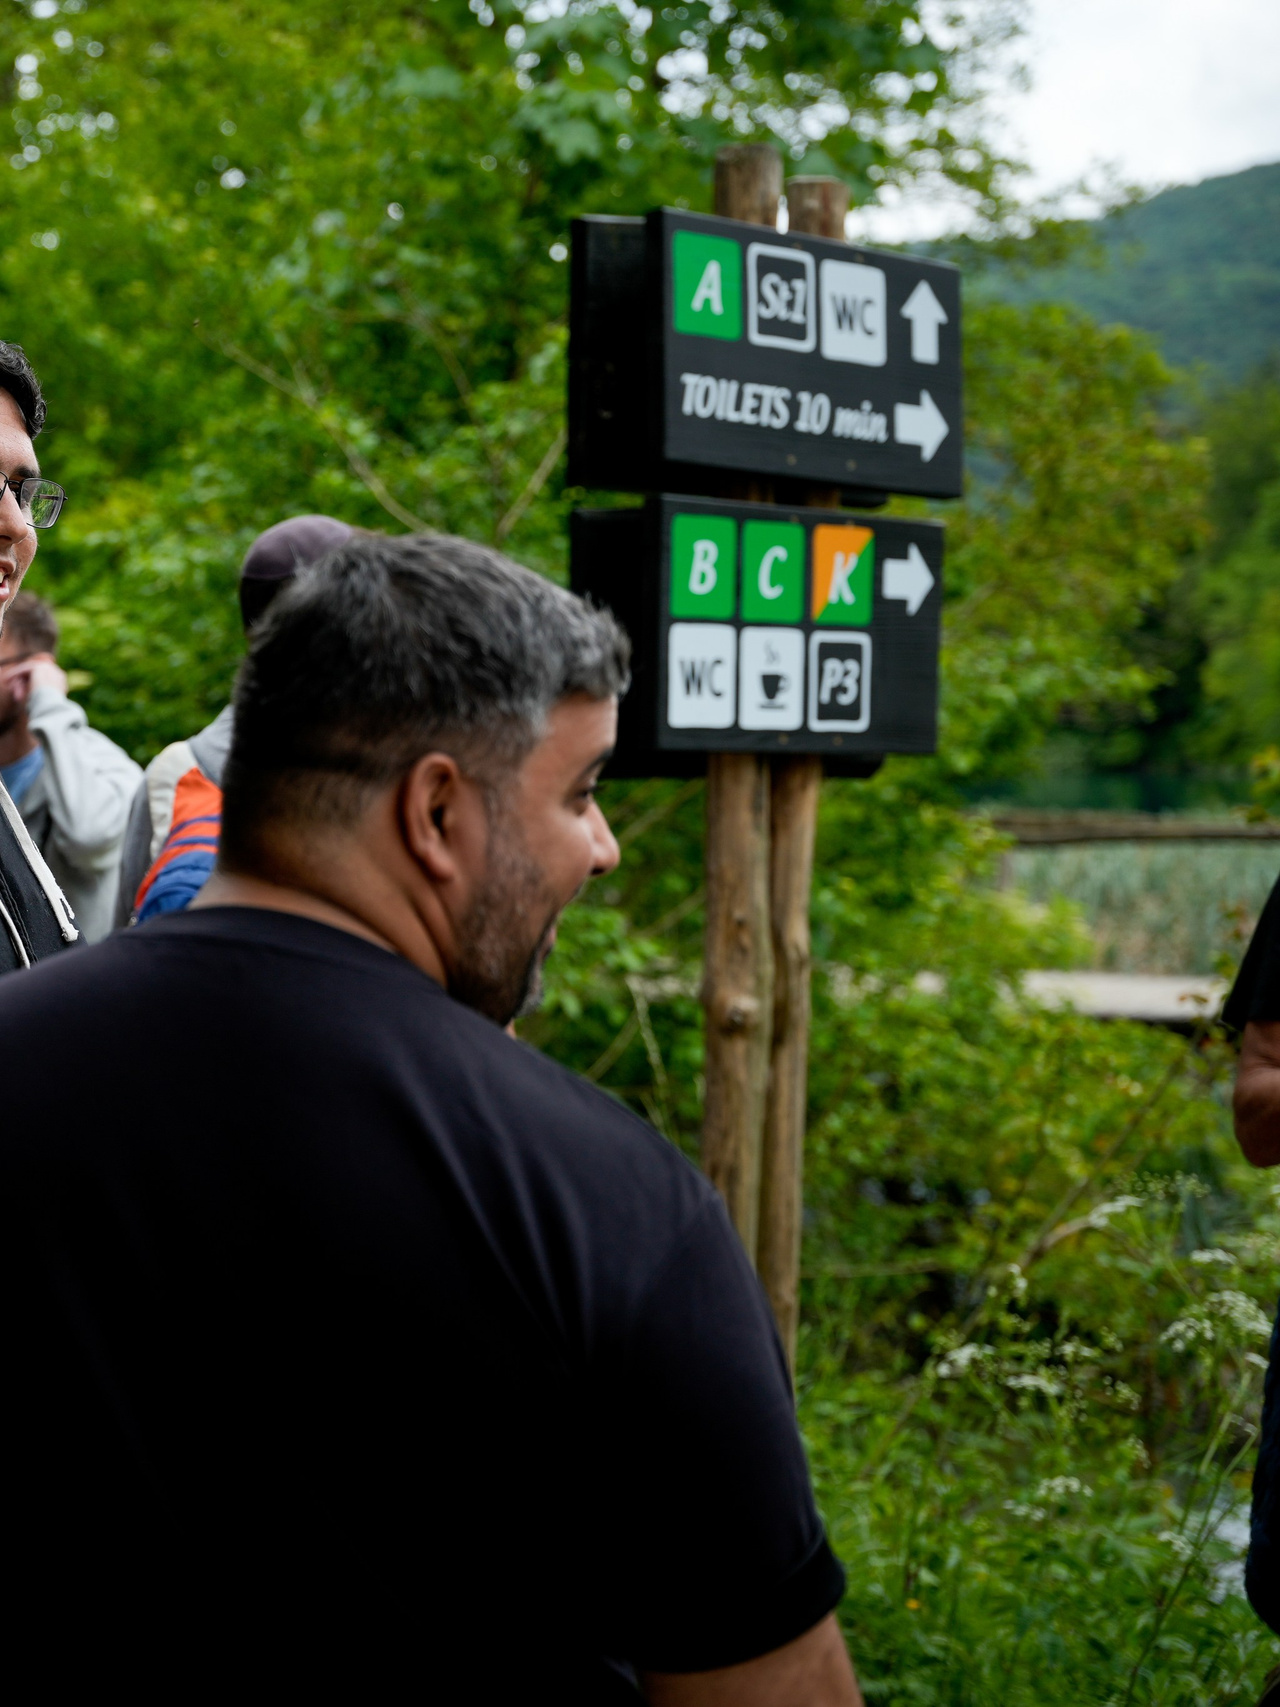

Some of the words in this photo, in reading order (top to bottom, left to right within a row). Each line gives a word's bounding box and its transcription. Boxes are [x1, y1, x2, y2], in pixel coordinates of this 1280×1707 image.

[690, 259, 724, 316] A
[758, 271, 807, 326] St1
[830, 293, 877, 338] WC
[680, 371, 792, 430] TOILETS
[794, 390, 832, 436] 10
[832, 400, 888, 444] min
[688, 539, 720, 596] B
[757, 545, 788, 600] C
[826, 550, 860, 606] K
[679, 658, 725, 699] WC
[820, 656, 860, 706] P3
